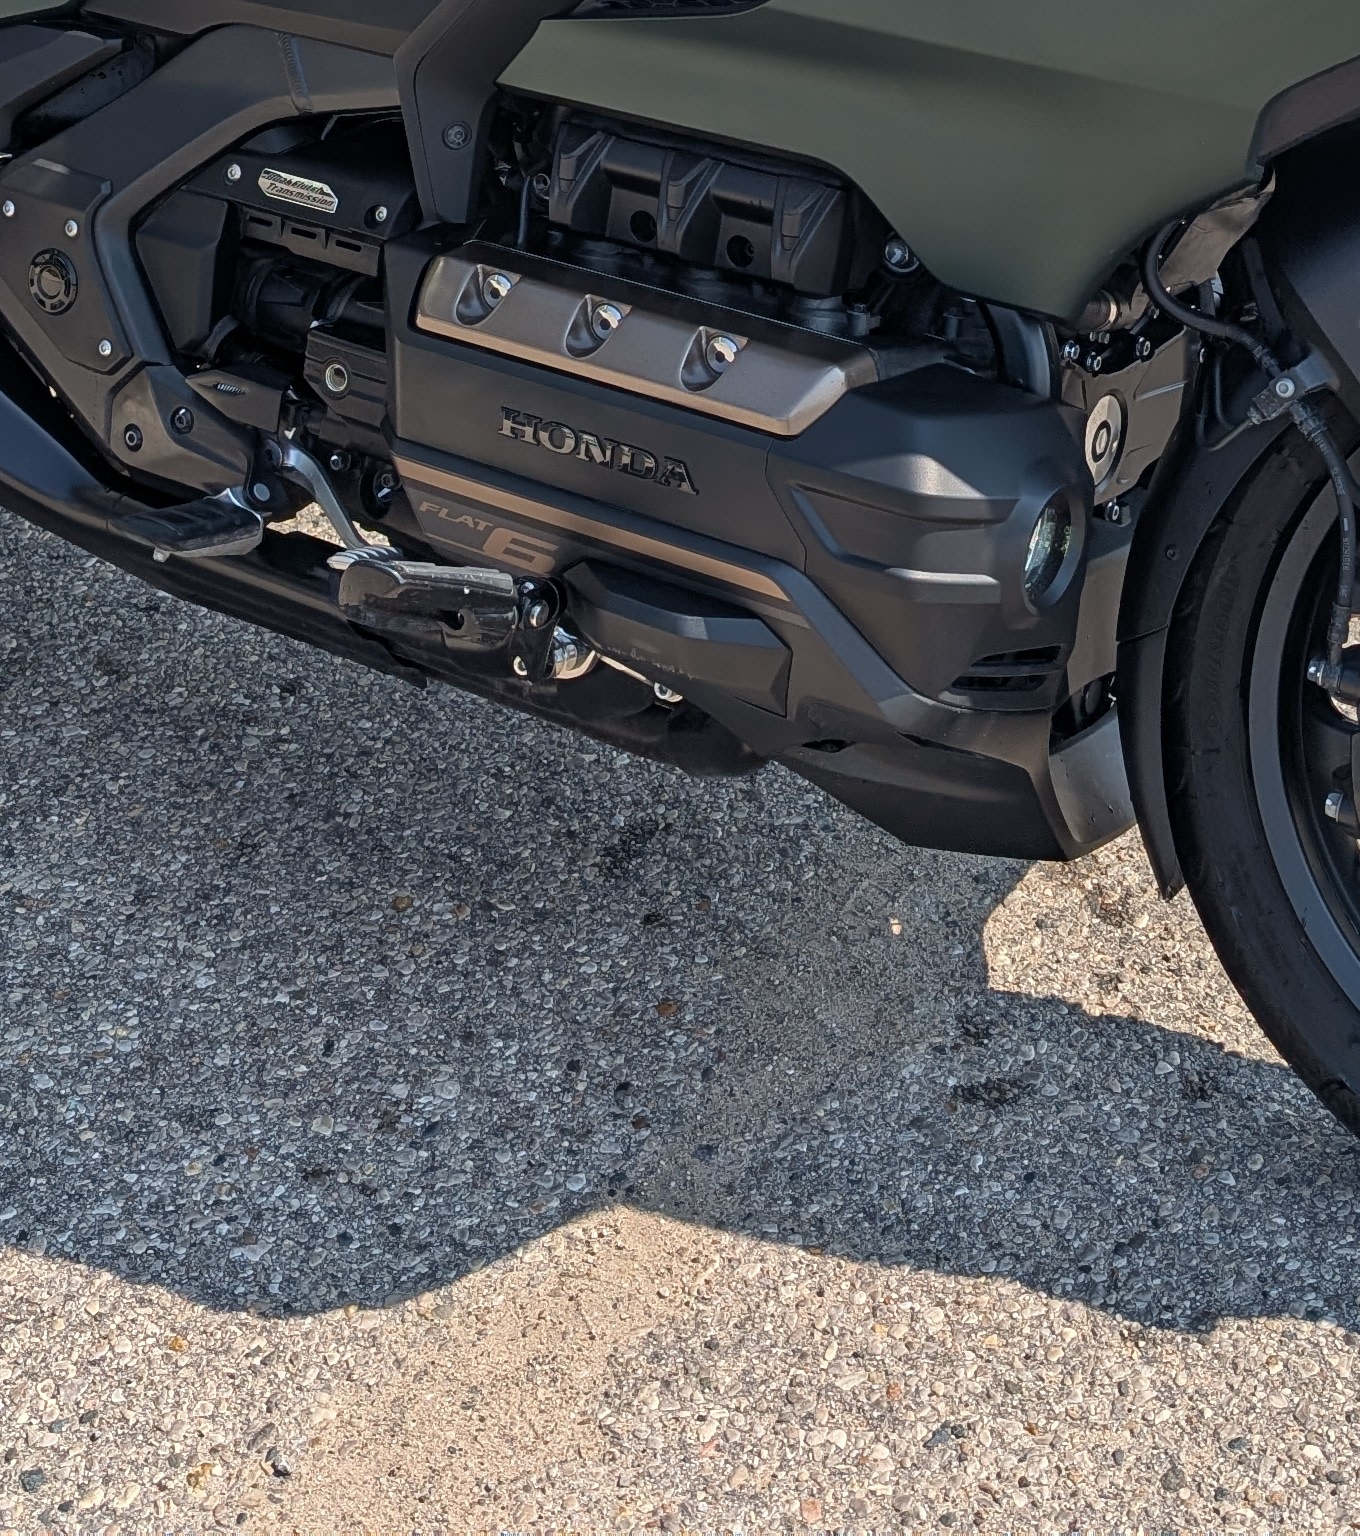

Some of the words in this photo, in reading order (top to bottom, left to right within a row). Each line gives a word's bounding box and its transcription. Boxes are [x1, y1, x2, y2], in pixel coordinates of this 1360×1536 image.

[266, 182, 335, 207] Transmission
[497, 405, 700, 496] HONDA
[419, 501, 494, 532] FLAT
[482, 527, 559, 575] 6
